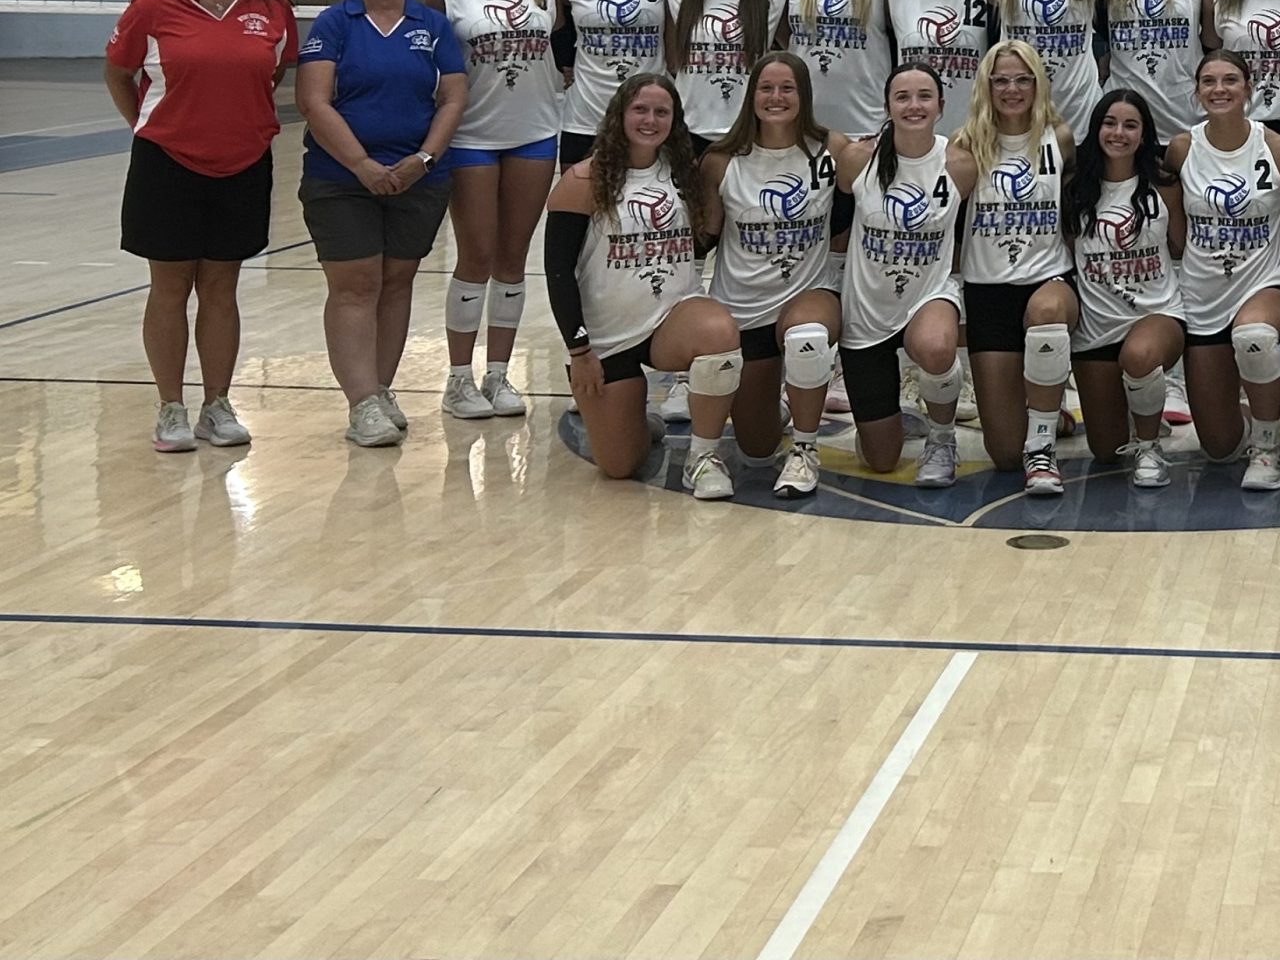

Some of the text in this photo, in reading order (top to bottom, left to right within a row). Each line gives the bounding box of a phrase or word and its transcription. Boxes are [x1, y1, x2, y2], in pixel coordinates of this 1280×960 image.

[1110, 17, 1190, 29] WEST NEBRASKA
[611, 35, 659, 49] STARS
[1111, 26, 1189, 43] ALL STARS
[928, 47, 979, 58] NEBRASKA
[1110, 40, 1188, 51] VOLLEYBALL
[929, 56, 978, 71] STARS
[1039, 144, 1056, 175] 11
[808, 154, 836, 190] 14
[1254, 159, 1273, 190] 2
[932, 175, 950, 208] 4
[1004, 200, 1057, 211] NEBRASKA
[972, 211, 1057, 227] ALL STARS
[1217, 214, 1269, 227] NEBRASKA
[608, 232, 639, 244] WEST
[1218, 224, 1270, 241] STARS
[607, 243, 639, 260] ALL
